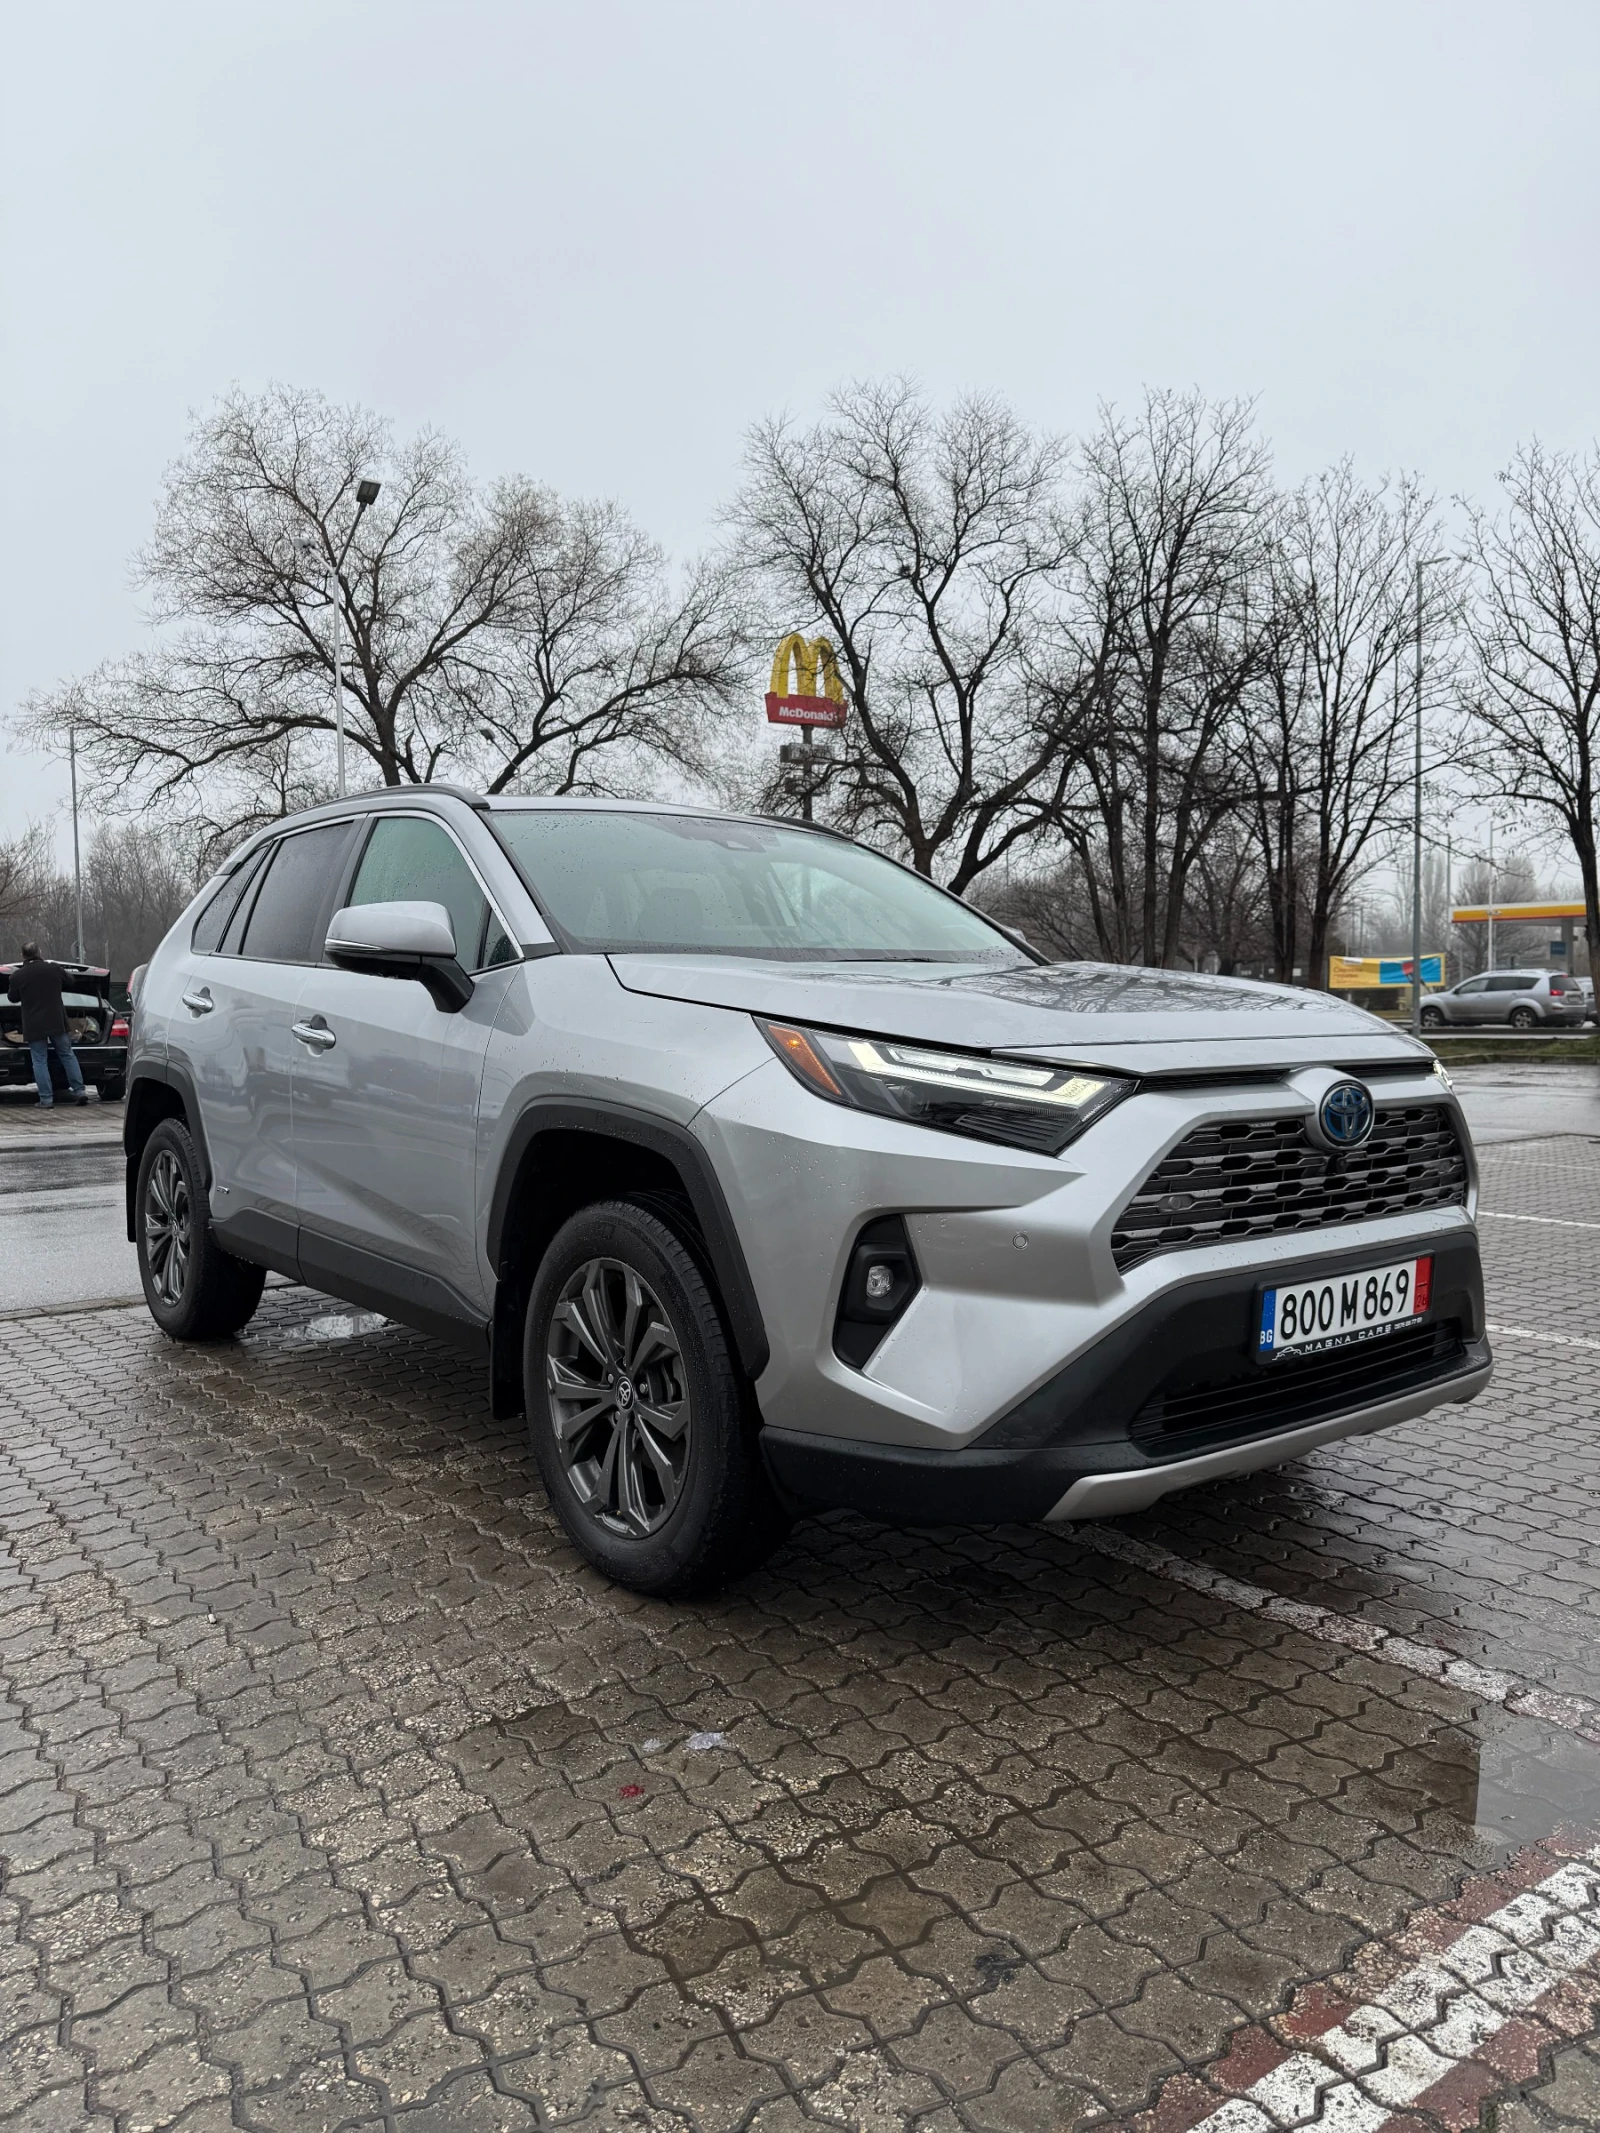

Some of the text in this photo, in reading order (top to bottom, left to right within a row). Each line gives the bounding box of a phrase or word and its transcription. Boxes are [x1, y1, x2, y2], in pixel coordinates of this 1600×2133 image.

[1259, 1330, 1273, 1345] BG
[1304, 1324, 1392, 1353] MAGNA CARS
